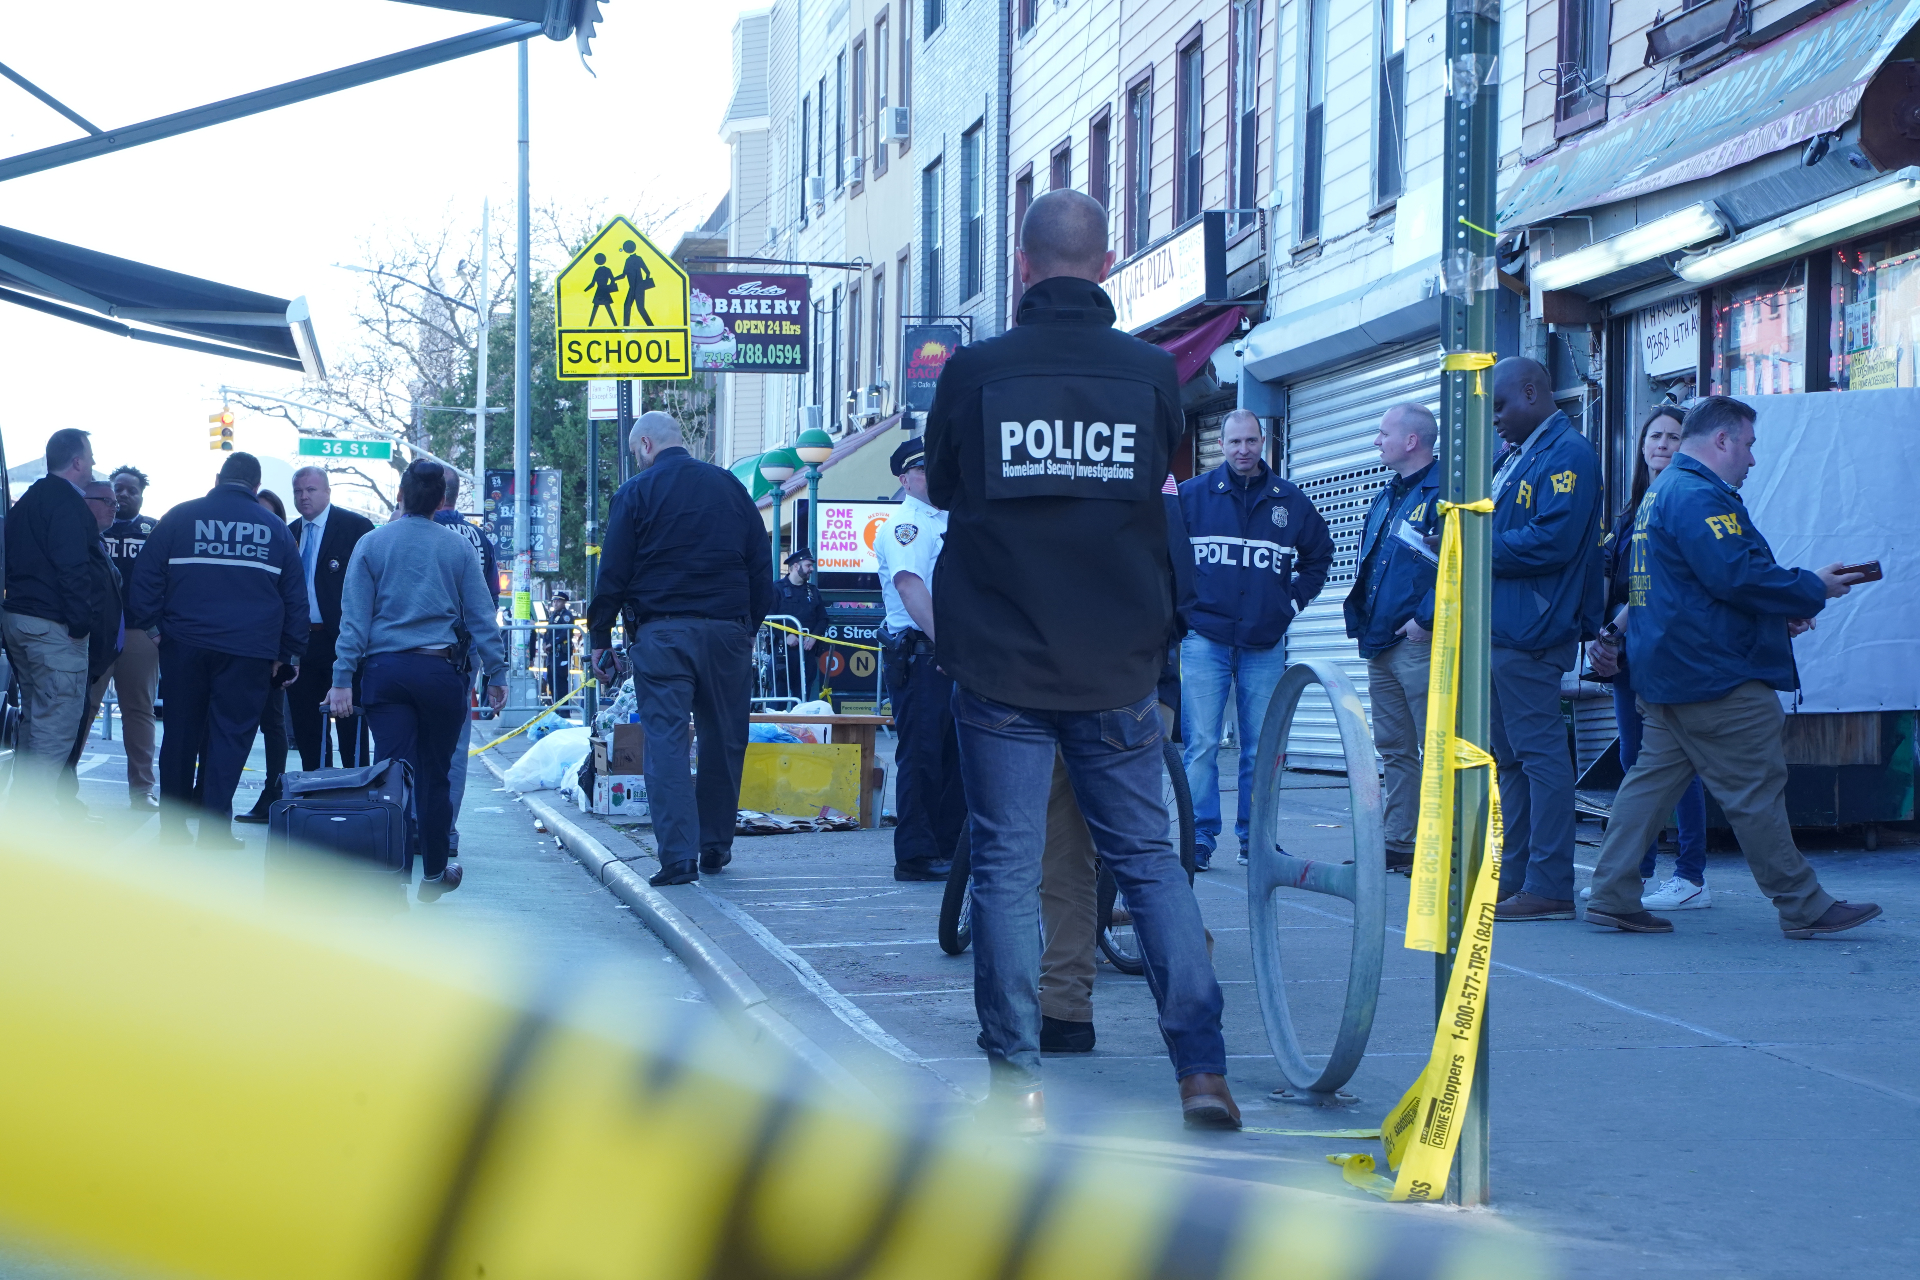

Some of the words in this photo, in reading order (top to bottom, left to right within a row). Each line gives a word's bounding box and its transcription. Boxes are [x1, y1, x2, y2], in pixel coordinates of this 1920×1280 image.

[1125, 262, 1145, 305] CAFE
[1147, 246, 1175, 293] PIZZA
[714, 298, 801, 315] BAKERY
[735, 320, 765, 334] OPEN
[767, 321, 780, 334] 24
[782, 321, 801, 335] Hrs
[1673, 319, 1690, 348] 4TH
[567, 340, 681, 363] SCHOOL
[322, 442, 342, 454] 36
[350, 443, 368, 456] St
[1001, 420, 1136, 462] POLICE
[1003, 460, 1044, 477] Homeland
[1047, 459, 1075, 480] Security
[1076, 461, 1134, 482] Investigations
[500, 506, 545, 518] BAEL
[826, 508, 853, 518] ONE
[867, 512, 890, 520] MEDIUM
[1408, 503, 1427, 522] BI
[195, 520, 272, 544] NYPD
[827, 519, 852, 529] FOR
[1705, 513, 1742, 539] FBI
[822, 530, 857, 540] EACH
[194, 542, 270, 560] POLICE
[821, 541, 858, 551] HAND
[818, 558, 864, 567] DUNKIN'
[1193, 543, 1283, 574] POLICE
[856, 657, 869, 671] N
[1431, 1054, 1465, 1148] CRIMEstoppers
[1451, 943, 1488, 1042] 1-800-577-TIPS
[1480, 902, 1496, 943] (8477)
